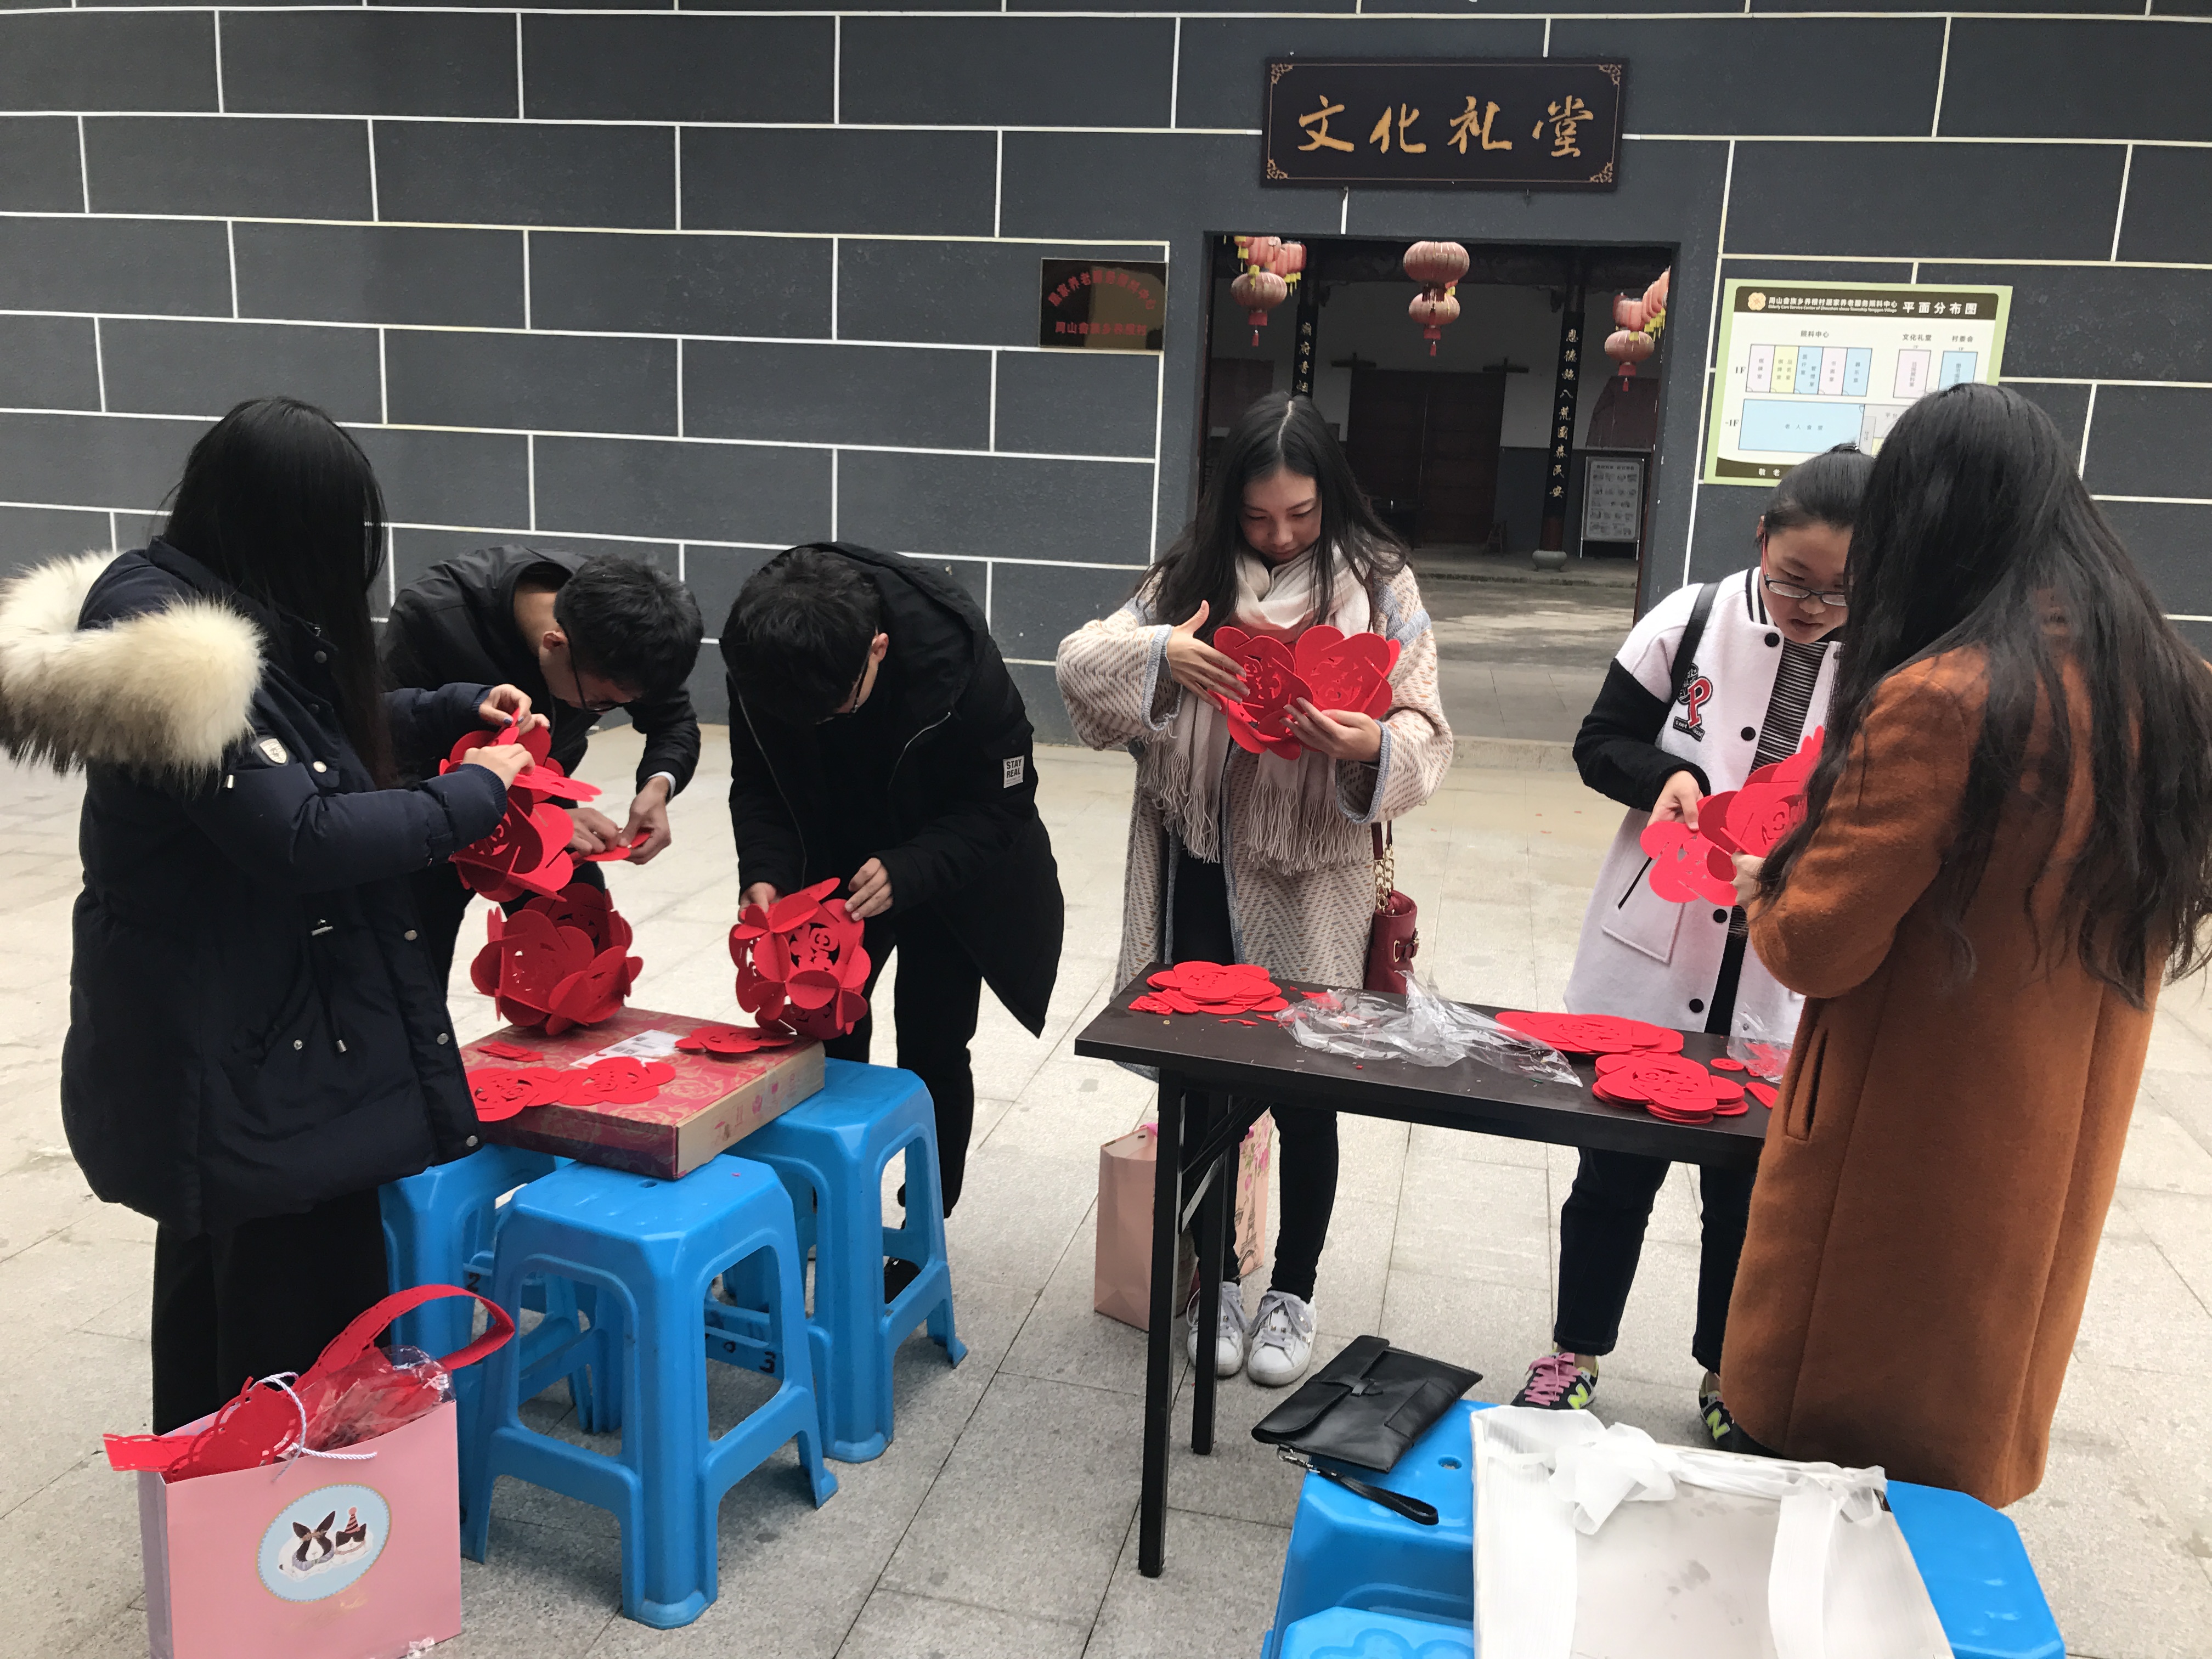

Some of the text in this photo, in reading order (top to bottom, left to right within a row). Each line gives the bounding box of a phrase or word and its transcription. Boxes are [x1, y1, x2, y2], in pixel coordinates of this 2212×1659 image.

[1297, 94, 1594, 159] 文化礼堂
[1902, 301, 1978, 315] 平面分布图
[1801, 330, 1830, 338] 照料中心
[1902, 333, 1932, 342] 文化礼堂
[1687, 676, 1713, 729] P
[1006, 758, 1022, 770] STAY
[1006, 768, 1021, 778] REAL
[466, 1272, 481, 1292] 2
